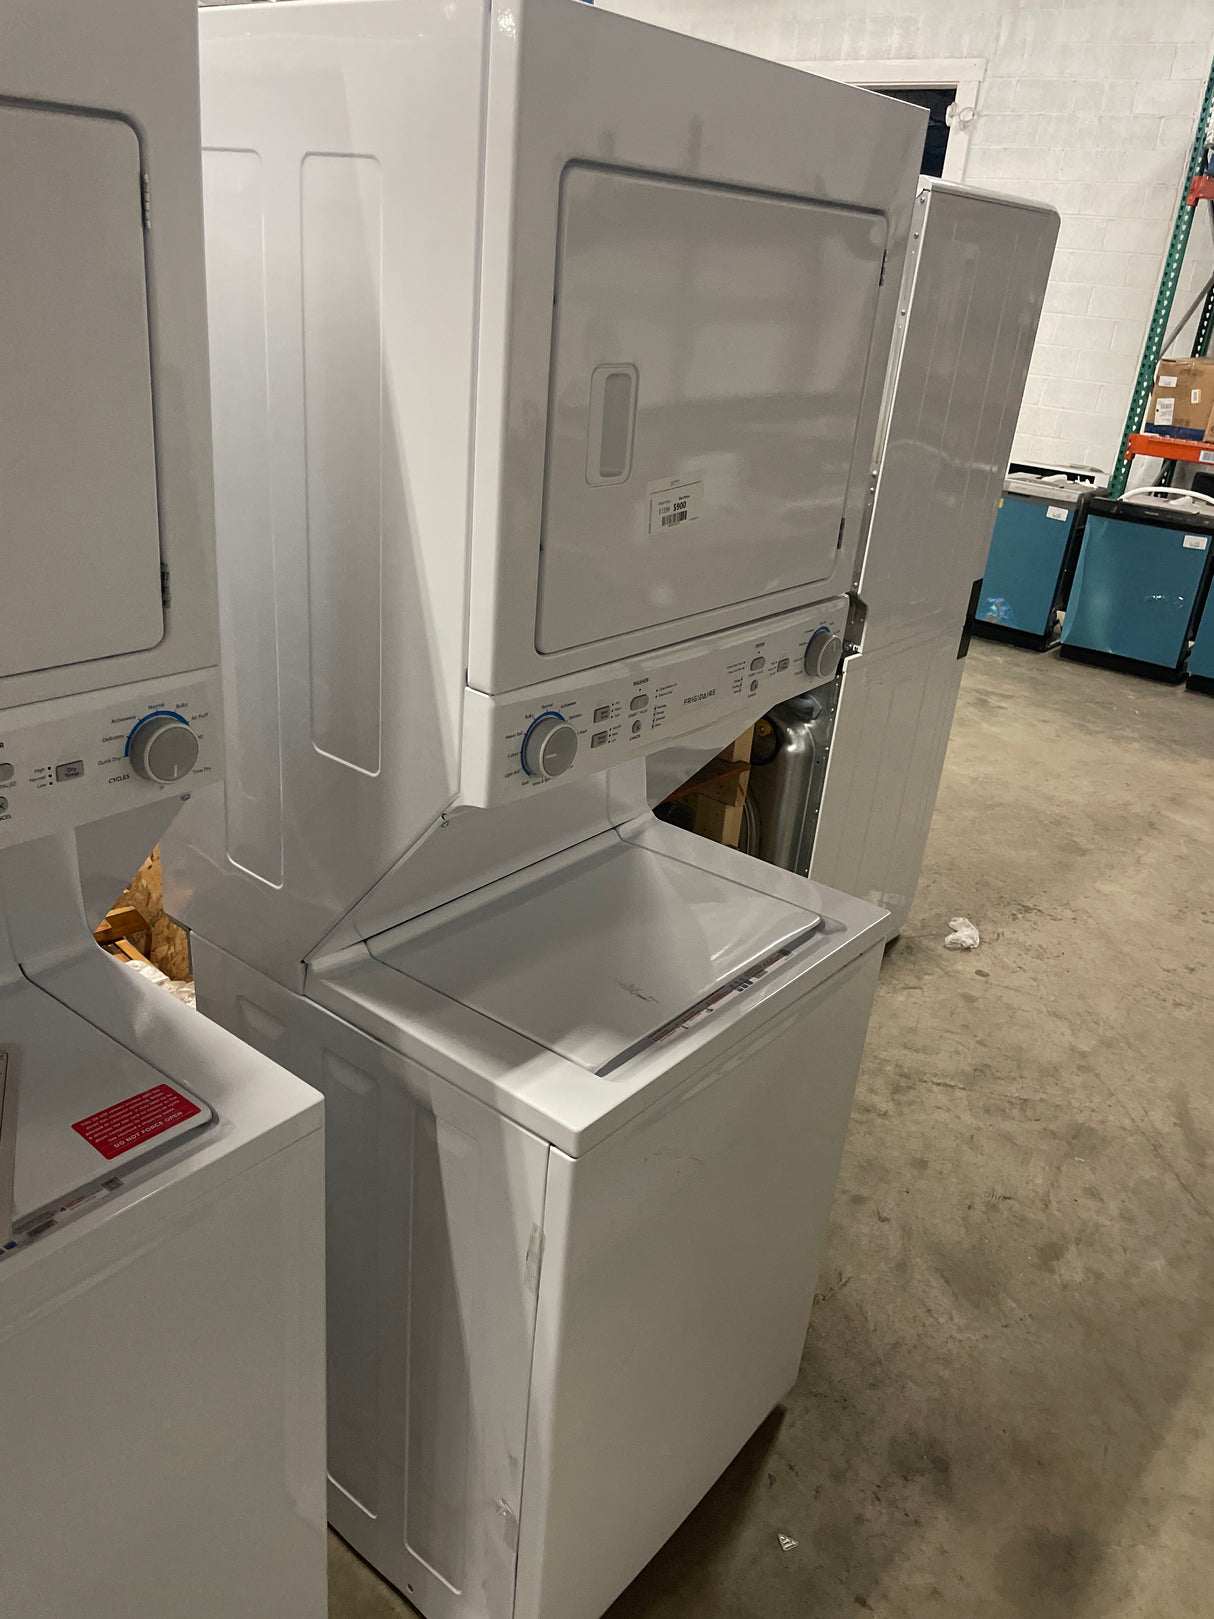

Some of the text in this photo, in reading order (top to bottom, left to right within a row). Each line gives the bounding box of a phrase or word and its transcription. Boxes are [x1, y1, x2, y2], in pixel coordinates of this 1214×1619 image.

[683, 688, 717, 706] FRIGIDAIRE
[108, 774, 130, 784] CYCLES
[113, 1111, 183, 1148] DO NOT FORCE OPEN
